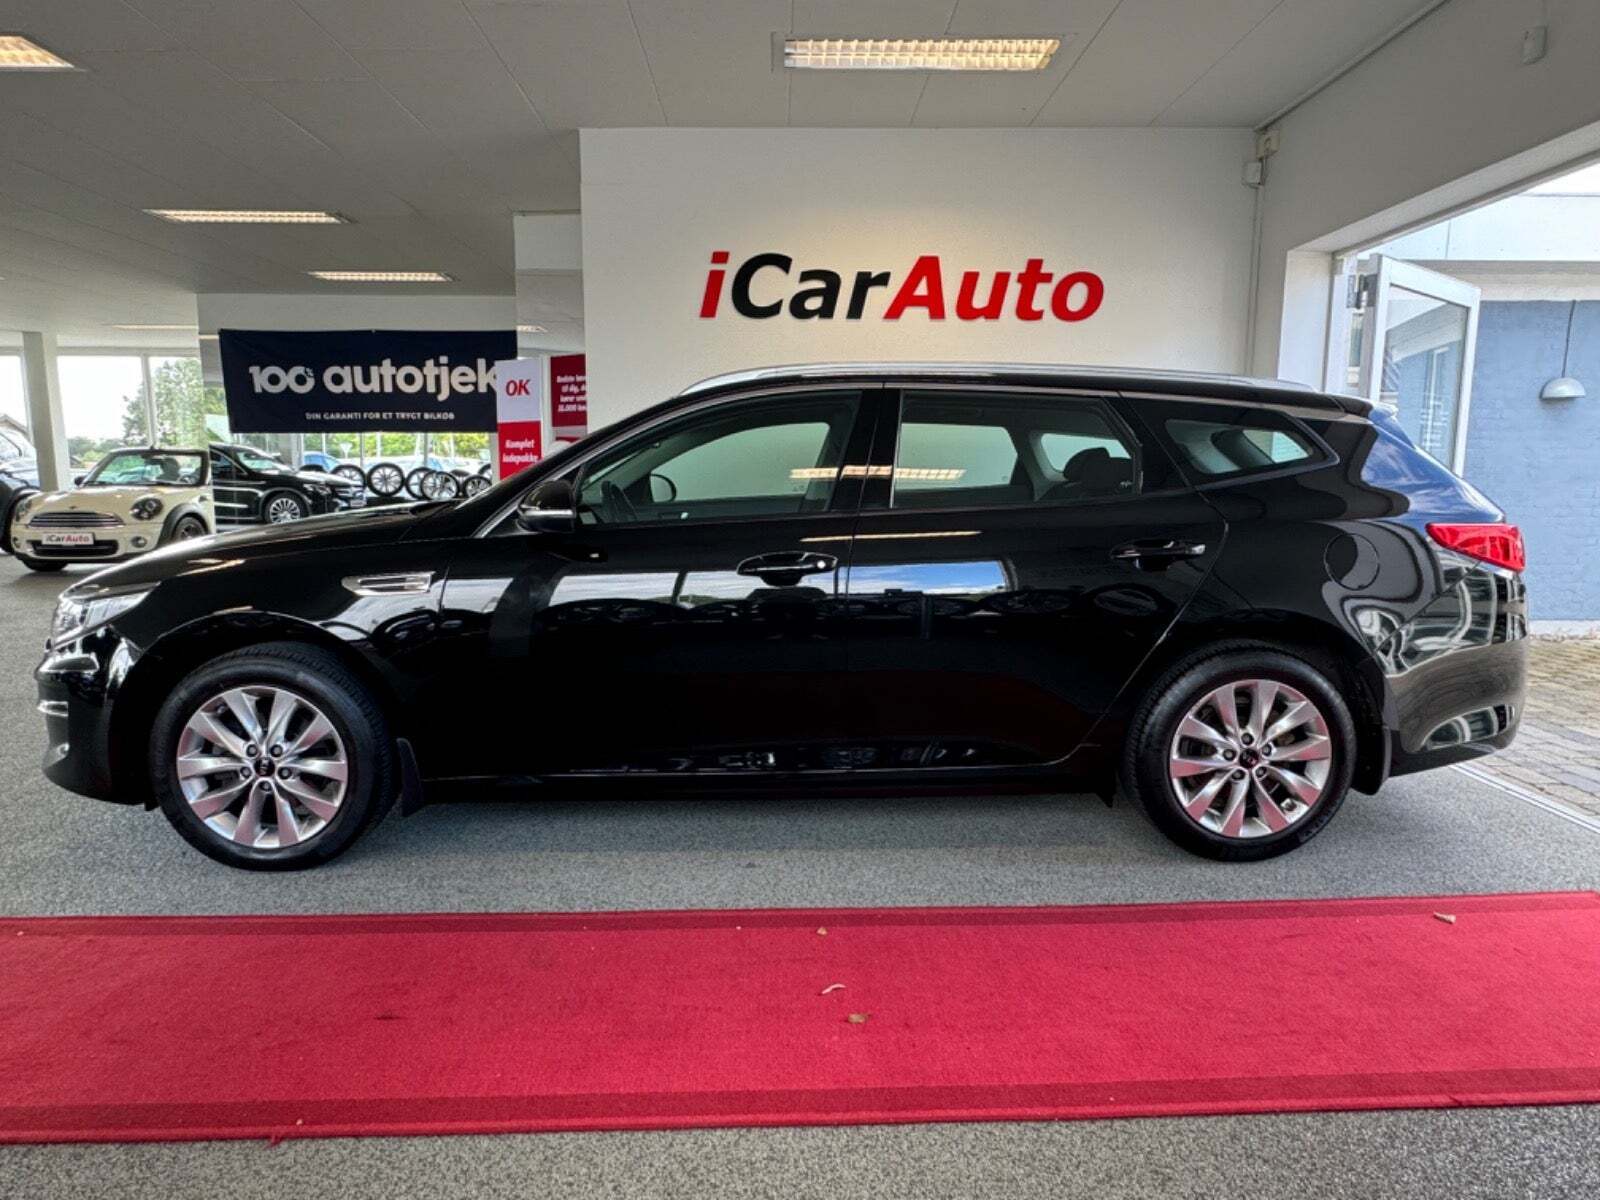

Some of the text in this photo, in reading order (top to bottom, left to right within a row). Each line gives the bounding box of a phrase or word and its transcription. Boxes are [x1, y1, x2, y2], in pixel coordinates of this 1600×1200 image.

[699, 251, 1105, 322] iCarAuto
[323, 356, 497, 402] autotjek
[505, 378, 531, 397] OK
[305, 411, 321, 420] DIN
[323, 411, 361, 420] GARANTI
[363, 411, 381, 420] FOR
[382, 411, 393, 420] ET
[395, 411, 421, 420] TRYGT
[504, 438, 535, 451] Komplet
[46, 534, 90, 543] iCarAuto
